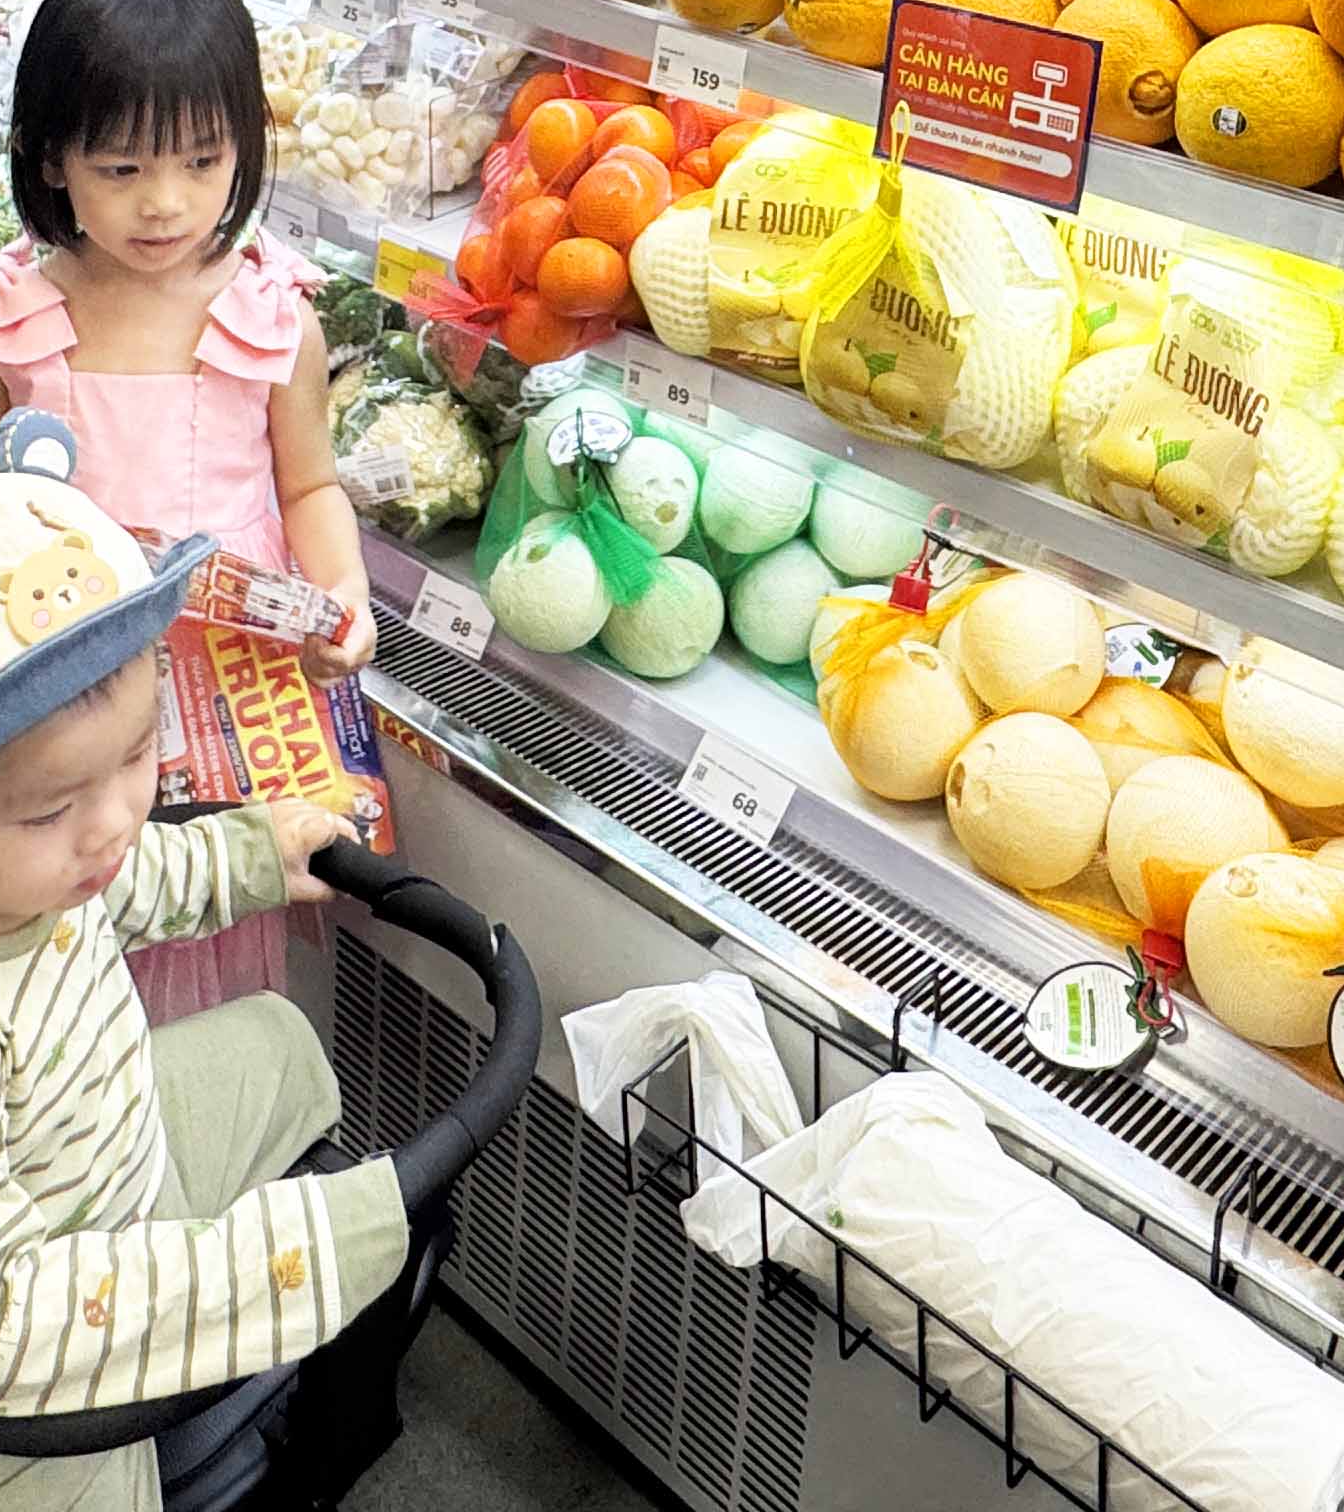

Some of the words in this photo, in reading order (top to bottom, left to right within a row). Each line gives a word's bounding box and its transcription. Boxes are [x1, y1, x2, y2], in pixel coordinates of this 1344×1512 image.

[343, 6, 358, 21] 25
[692, 69, 720, 90] 159
[899, 42, 942, 70] CÂN
[947, 53, 1008, 86] HÀNG
[897, 69, 923, 91] TẠI
[927, 75, 963, 100] BÀN
[968, 85, 1005, 110] CÂN
[914, 120, 929, 133] Để
[931, 125, 959, 143] thanh
[961, 131, 984, 149] toán
[985, 138, 1018, 156] nhanh
[1019, 145, 1042, 163] hơn!
[288, 222, 304, 238] 29
[720, 192, 751, 231] LÊ
[667, 385, 689, 405] 89
[1154, 333, 1180, 385] LÊ
[1184, 351, 1270, 438] ĐƯỜNG
[450, 616, 472, 638] 88
[216, 631, 290, 802] TRƯƠN
[263, 662, 330, 786] KHAI
[732, 791, 759, 818] 68
